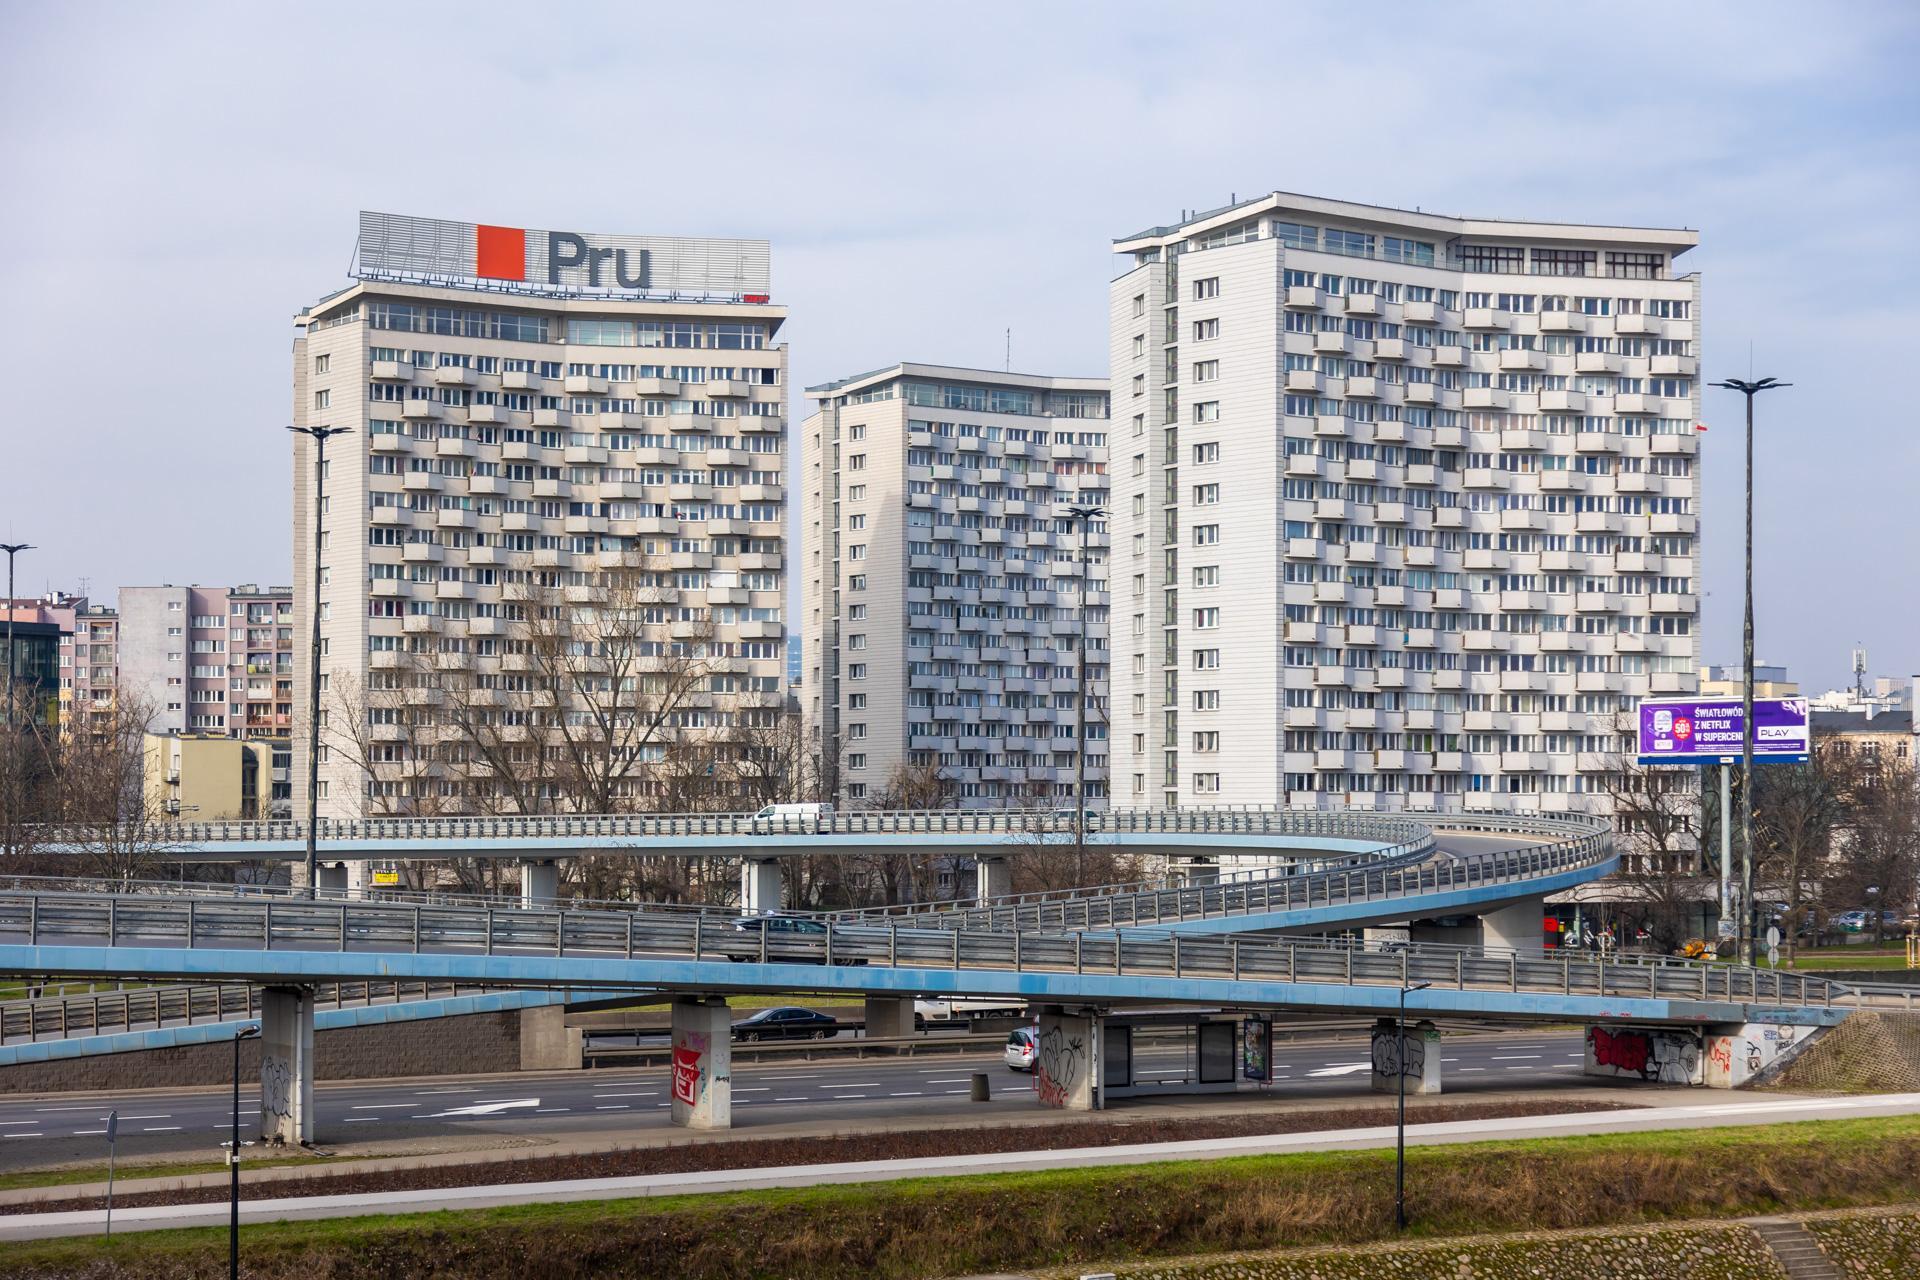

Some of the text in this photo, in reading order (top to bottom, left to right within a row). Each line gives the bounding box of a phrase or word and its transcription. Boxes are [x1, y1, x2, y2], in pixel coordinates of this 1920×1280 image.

[548, 231, 651, 289] Pru
[1694, 705, 1744, 718] ŚWIATŁOWÓD
[1674, 723, 1686, 733] 50
[1694, 720, 1701, 730] Z
[1701, 720, 1731, 730] NETFLIX
[1694, 732, 1702, 742] W
[1703, 731, 1744, 742] SUPERCENI
[1760, 729, 1790, 737] PLAY
